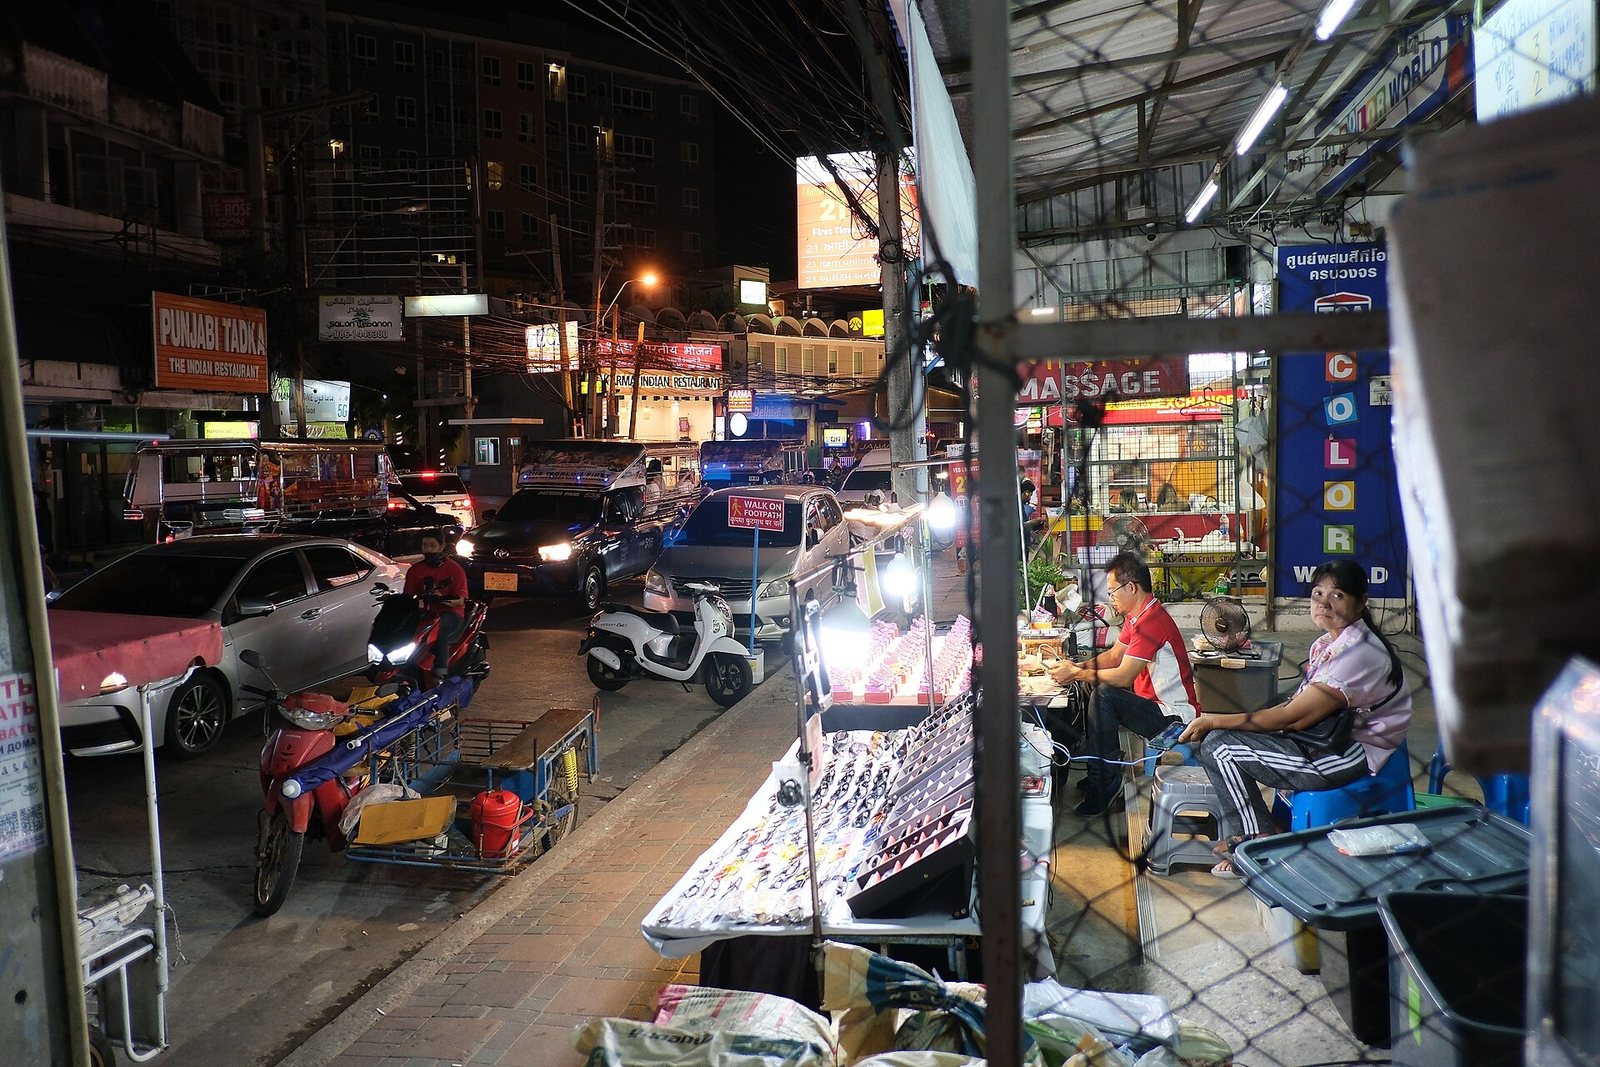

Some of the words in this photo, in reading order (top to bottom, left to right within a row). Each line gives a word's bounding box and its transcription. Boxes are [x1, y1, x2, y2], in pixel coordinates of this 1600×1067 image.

[1388, 36, 1442, 107] WORLD
[1309, 267, 1378, 281] ครบวงจร
[160, 307, 220, 351] PUNJABI
[221, 317, 266, 356] TADKA
[169, 357, 186, 374] THE
[187, 359, 213, 376] INDIAN
[214, 361, 260, 379] RESTAURANT
[602, 373, 635, 387] KRMA
[640, 375, 670, 387] INDIAN
[673, 376, 721, 389] RESTAURANT
[1016, 370, 1162, 401] MASSAGE
[337, 403, 348, 418] 5G
[744, 500, 768, 510] WALK
[769, 502, 782, 511] ON
[744, 509, 782, 519] FOOTPATH
